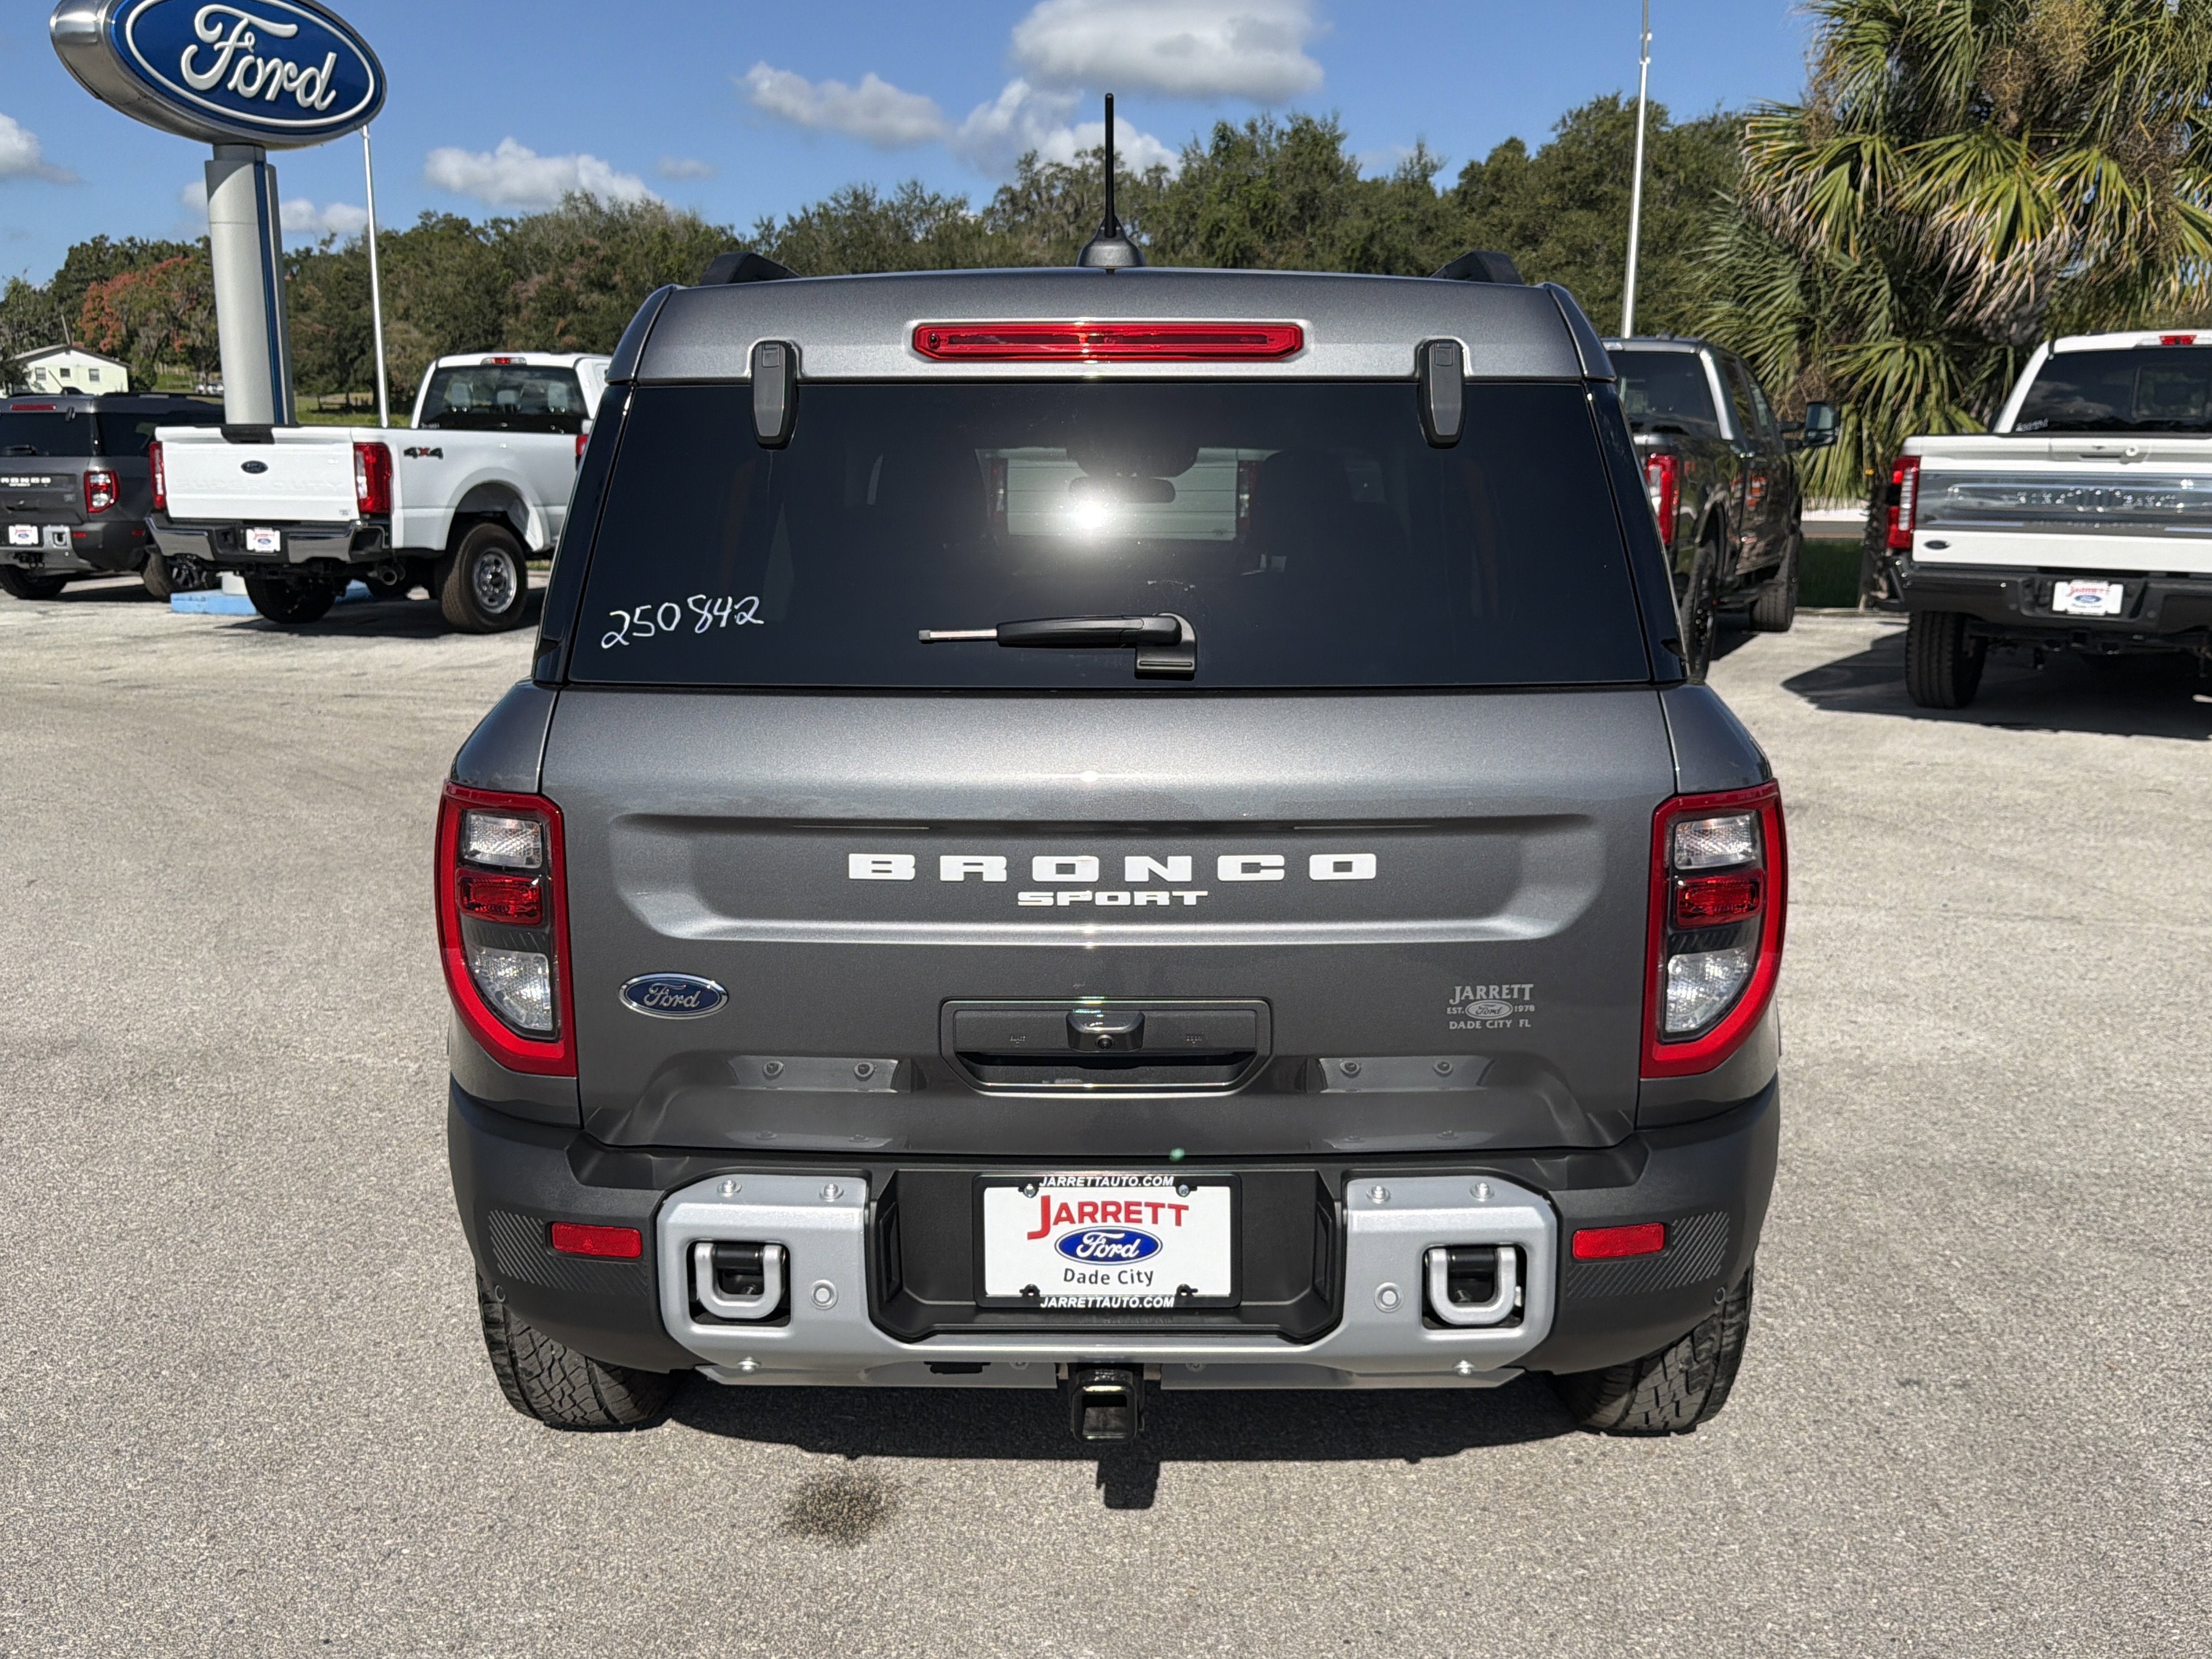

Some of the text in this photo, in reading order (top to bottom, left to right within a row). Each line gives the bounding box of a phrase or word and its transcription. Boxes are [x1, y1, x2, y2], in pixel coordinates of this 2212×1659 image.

[180, 4, 337, 111] Ford
[848, 853, 1377, 882] BRONCO
[1017, 890, 1208, 906] SPORT
[643, 983, 700, 1008] Ford
[1448, 984, 1534, 1005] JARRETT
[1475, 1005, 1503, 1015] Ford
[1514, 1005, 1535, 1013] 1978
[1449, 1019, 1531, 1030] DADE CITY FL
[1039, 1175, 1174, 1188] JARRETTAUTO.COM
[1027, 1195, 1189, 1240] JARRETT
[1076, 1231, 1141, 1259] Ford
[1063, 1268, 1154, 1287] Dade City
[1040, 1296, 1175, 1308] JARRETTAUTO.COM
